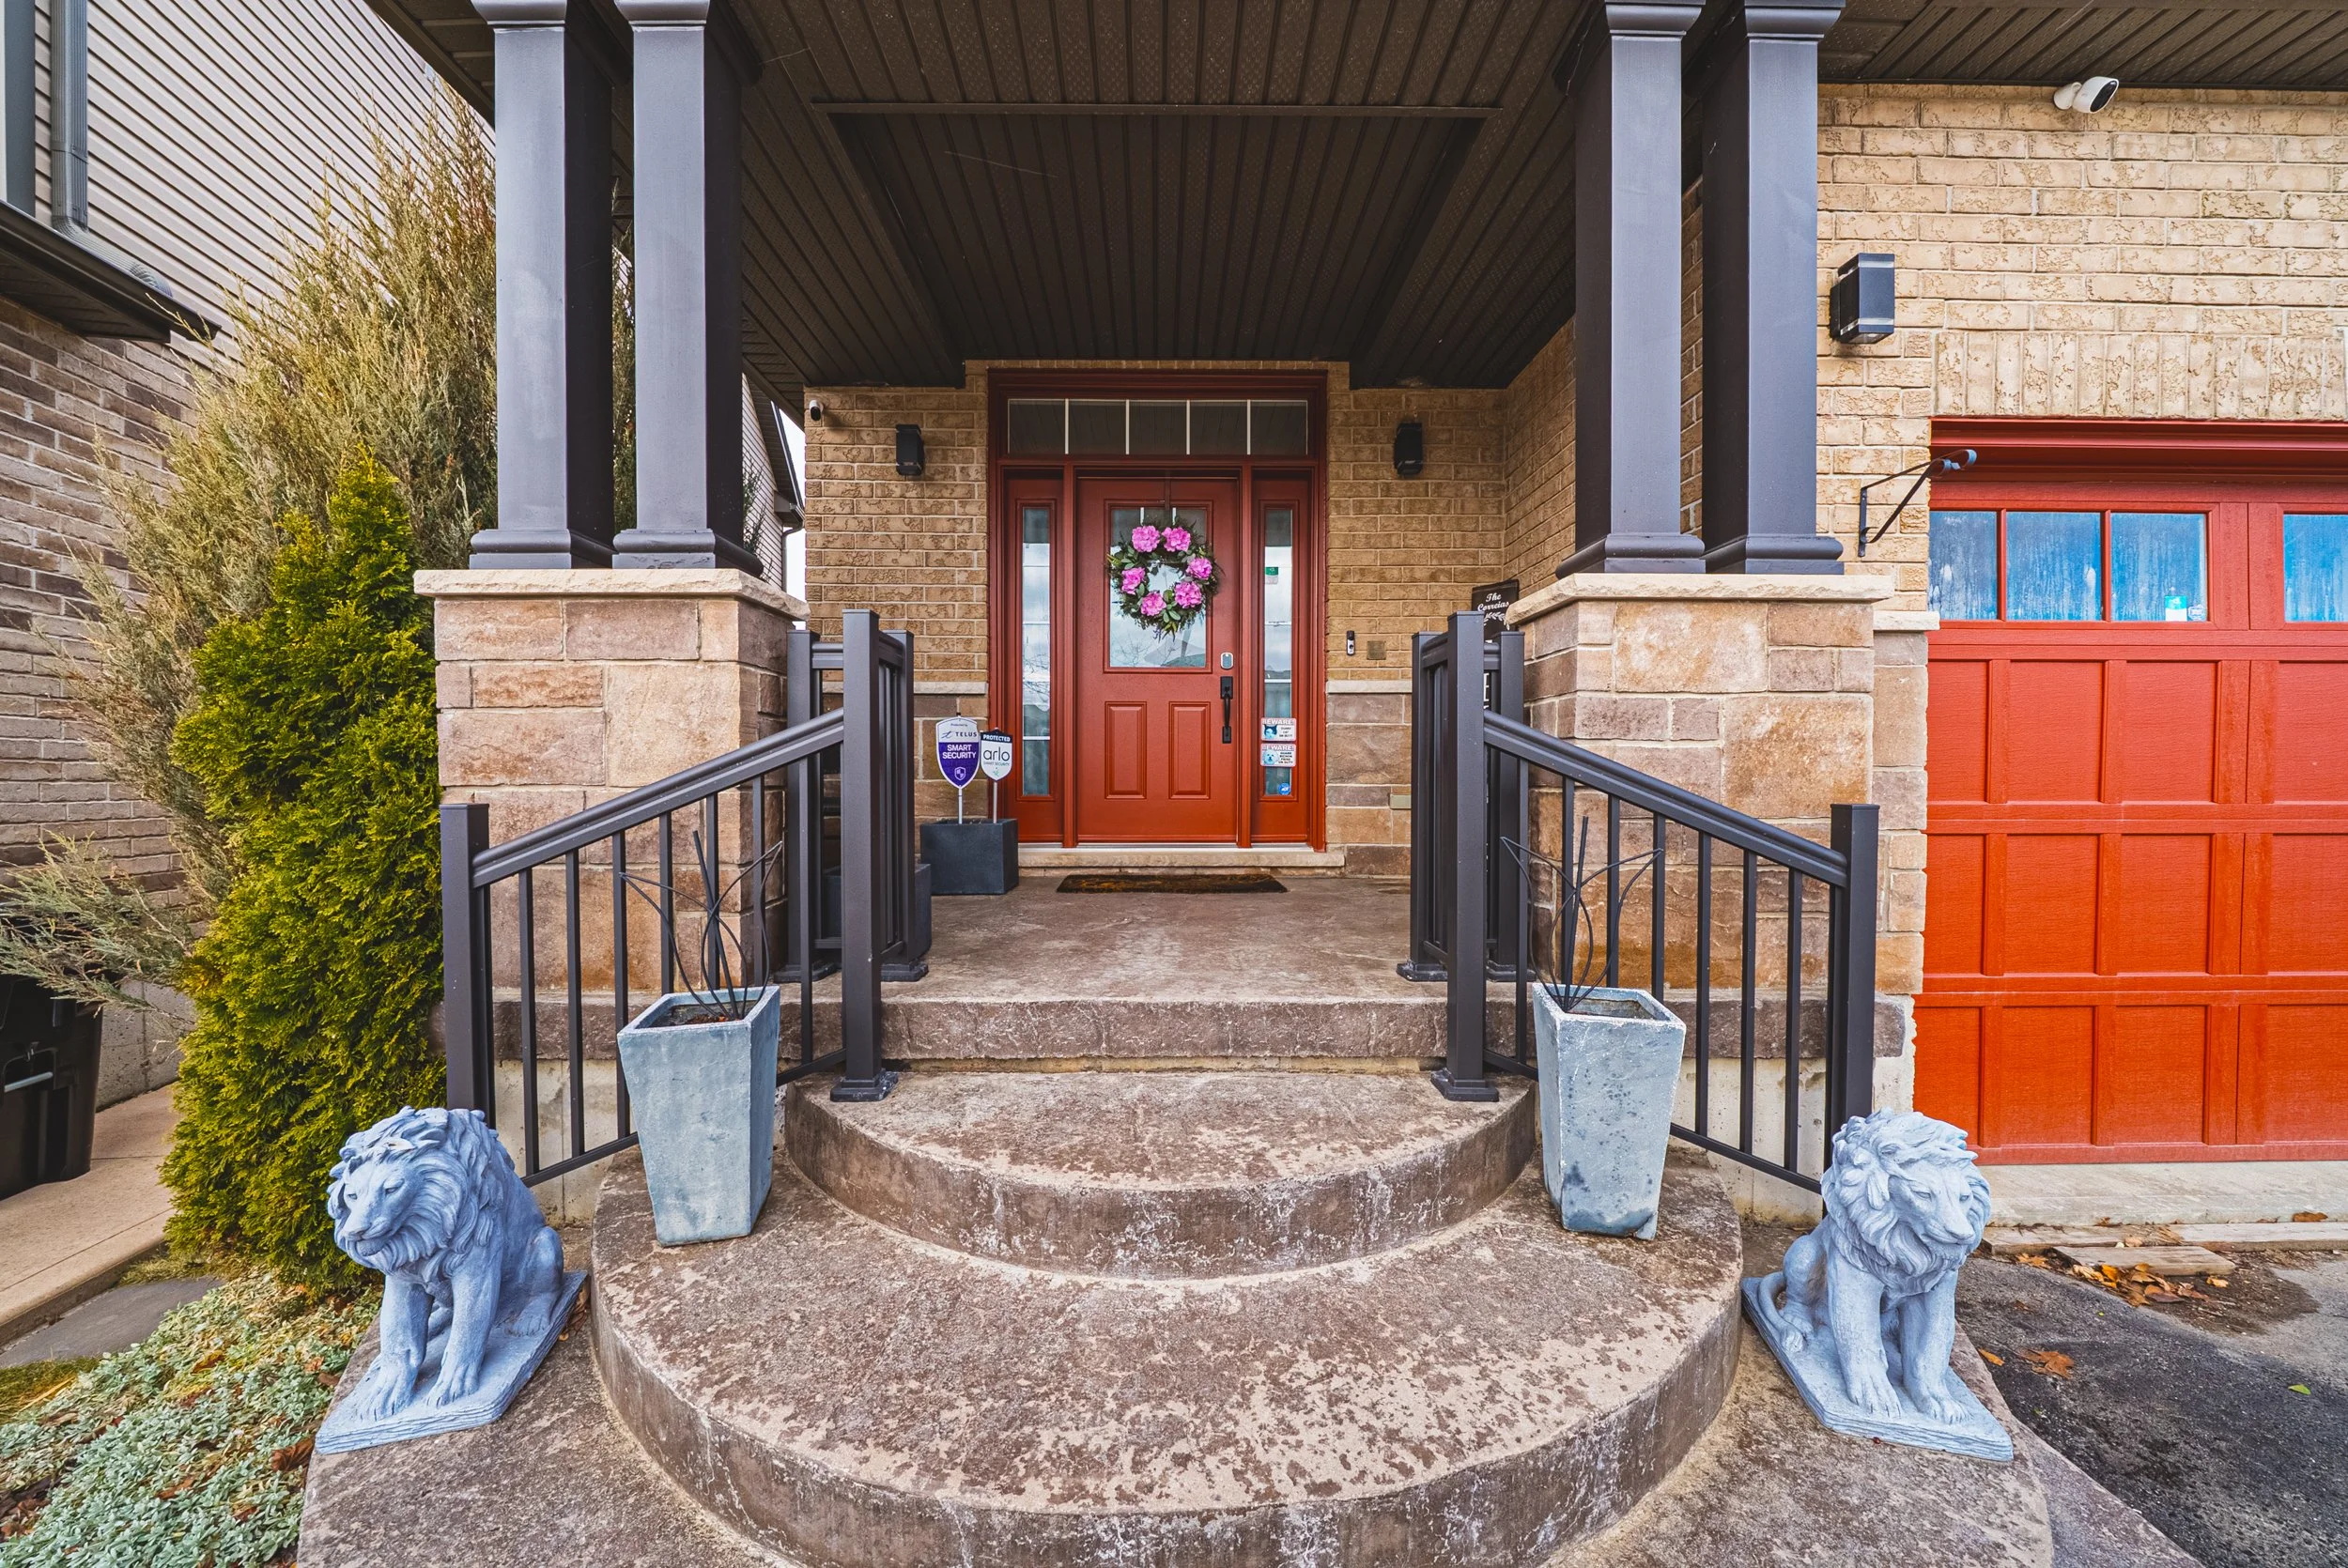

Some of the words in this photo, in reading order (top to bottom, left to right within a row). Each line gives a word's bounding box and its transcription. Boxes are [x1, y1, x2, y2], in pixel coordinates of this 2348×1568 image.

[1485, 592, 1502, 602] The
[1477, 601, 1509, 611] Correias
[942, 751, 977, 760] SECURITY
[983, 746, 1011, 761] arlo
